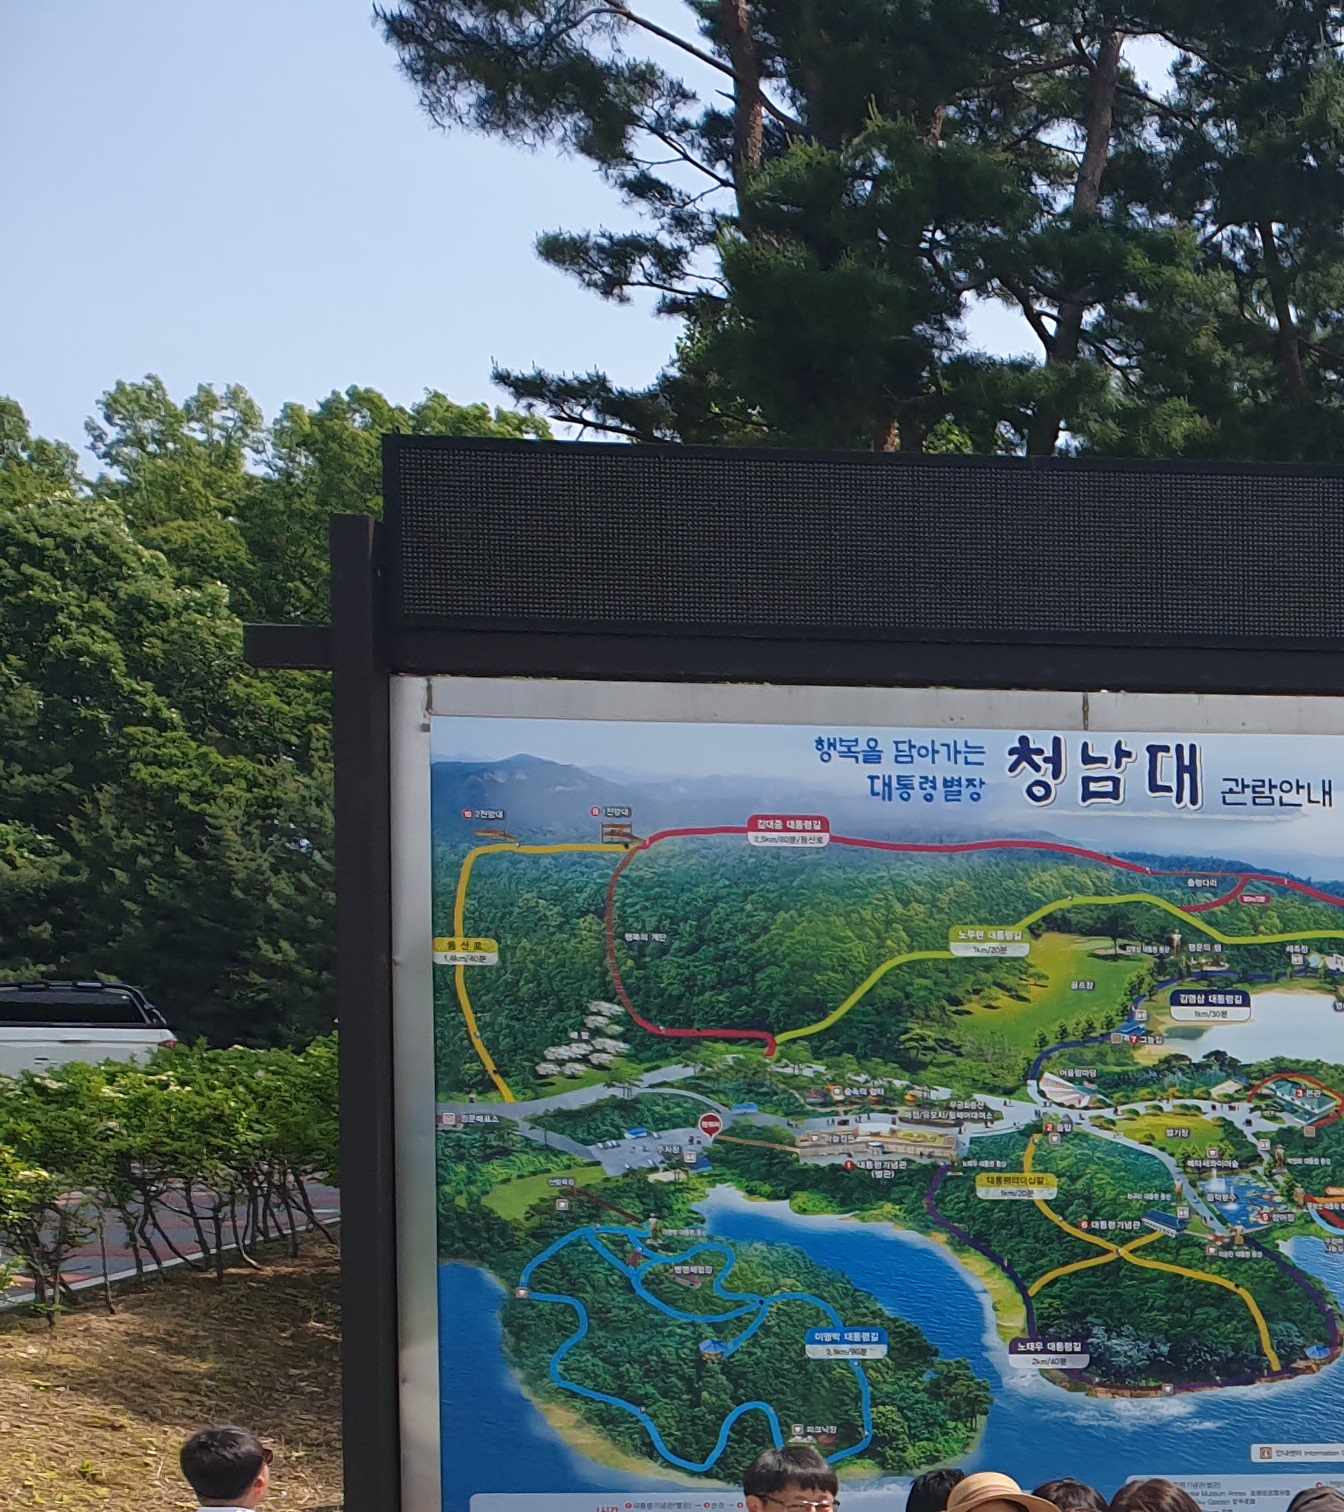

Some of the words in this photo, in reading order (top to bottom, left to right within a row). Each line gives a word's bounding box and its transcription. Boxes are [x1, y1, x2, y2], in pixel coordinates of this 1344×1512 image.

[814, 736, 884, 765] 행복을
[893, 739, 986, 766] 담아가는
[1007, 735, 1198, 806] 청남대
[1221, 777, 1333, 807] 관람안내
[1018, 1342, 1043, 1352] 노태우
[1047, 1342, 1082, 1352] 대통령길
